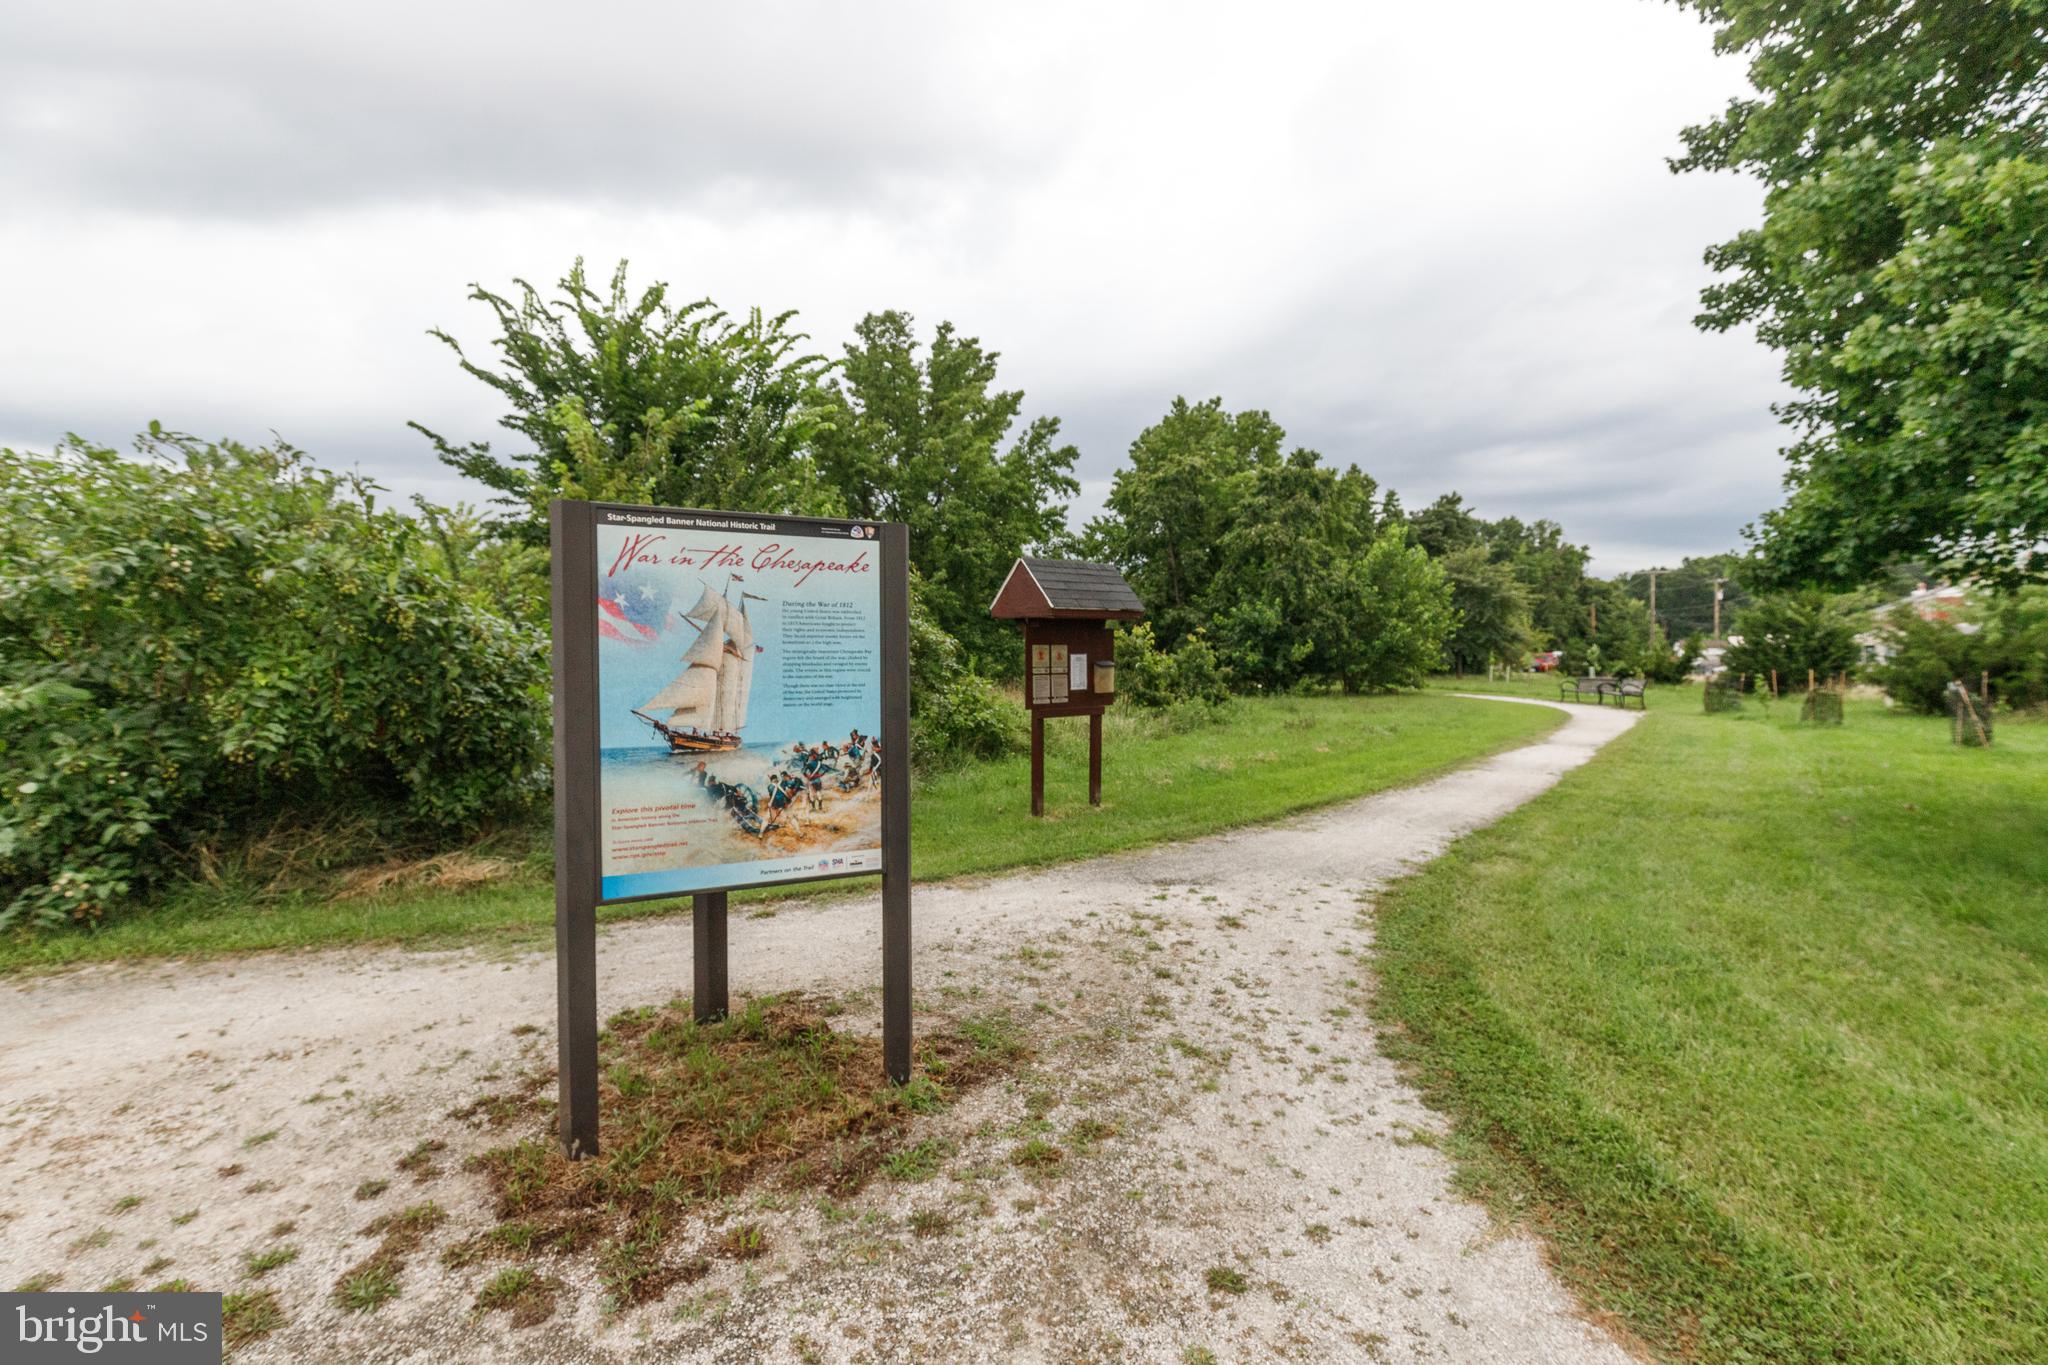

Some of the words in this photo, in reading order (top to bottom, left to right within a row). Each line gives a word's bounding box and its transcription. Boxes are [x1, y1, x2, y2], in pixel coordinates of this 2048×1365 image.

[607, 513, 665, 525] Star-Spangled
[666, 516, 694, 526] Banner
[696, 518, 729, 529] National
[730, 520, 758, 530] Historic
[760, 522, 776, 531] Trail
[608, 533, 667, 578] War
[670, 547, 697, 566] in
[687, 544, 746, 570] the
[751, 543, 870, 588] Chesapeake
[782, 600, 805, 609] During
[806, 600, 816, 608] the
[654, 804, 680, 813] pivotal
